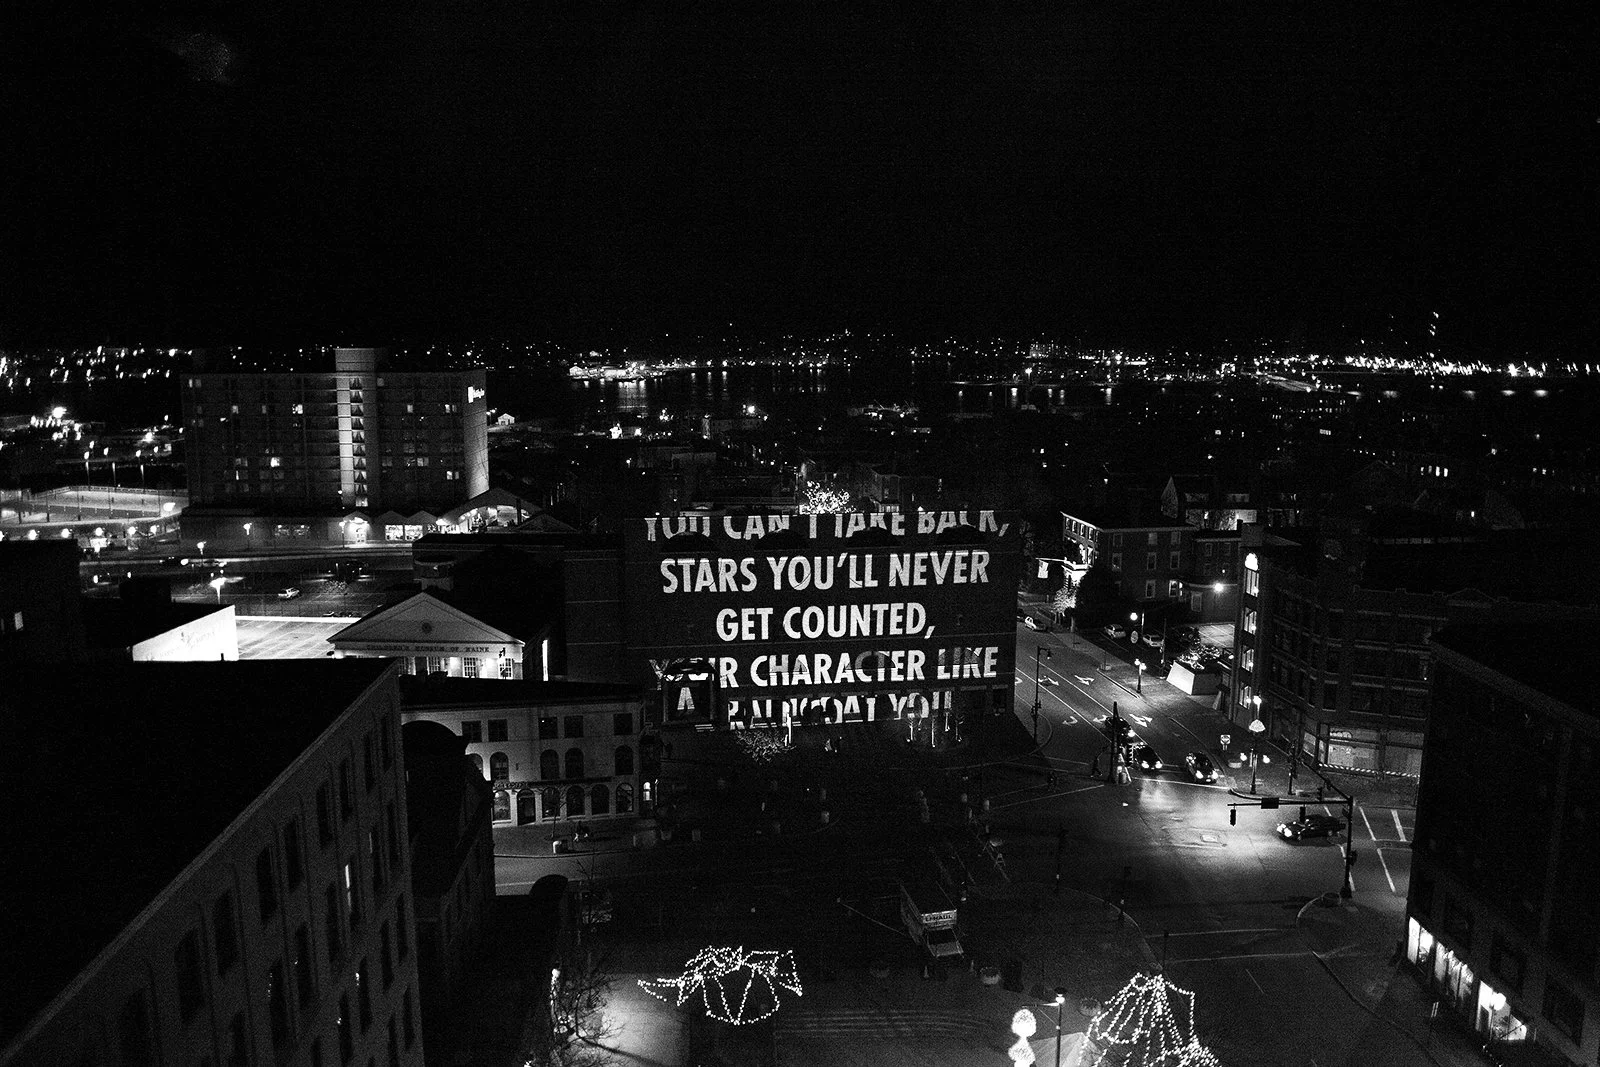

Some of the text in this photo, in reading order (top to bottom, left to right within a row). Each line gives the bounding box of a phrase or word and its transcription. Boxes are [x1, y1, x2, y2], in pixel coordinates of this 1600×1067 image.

[723, 513, 817, 541] CANT
[660, 549, 990, 594] STARS YOU'LL NEVER
[716, 601, 935, 642] GET COUNTED,
[649, 646, 999, 690] YR CHARACTER LIKE
